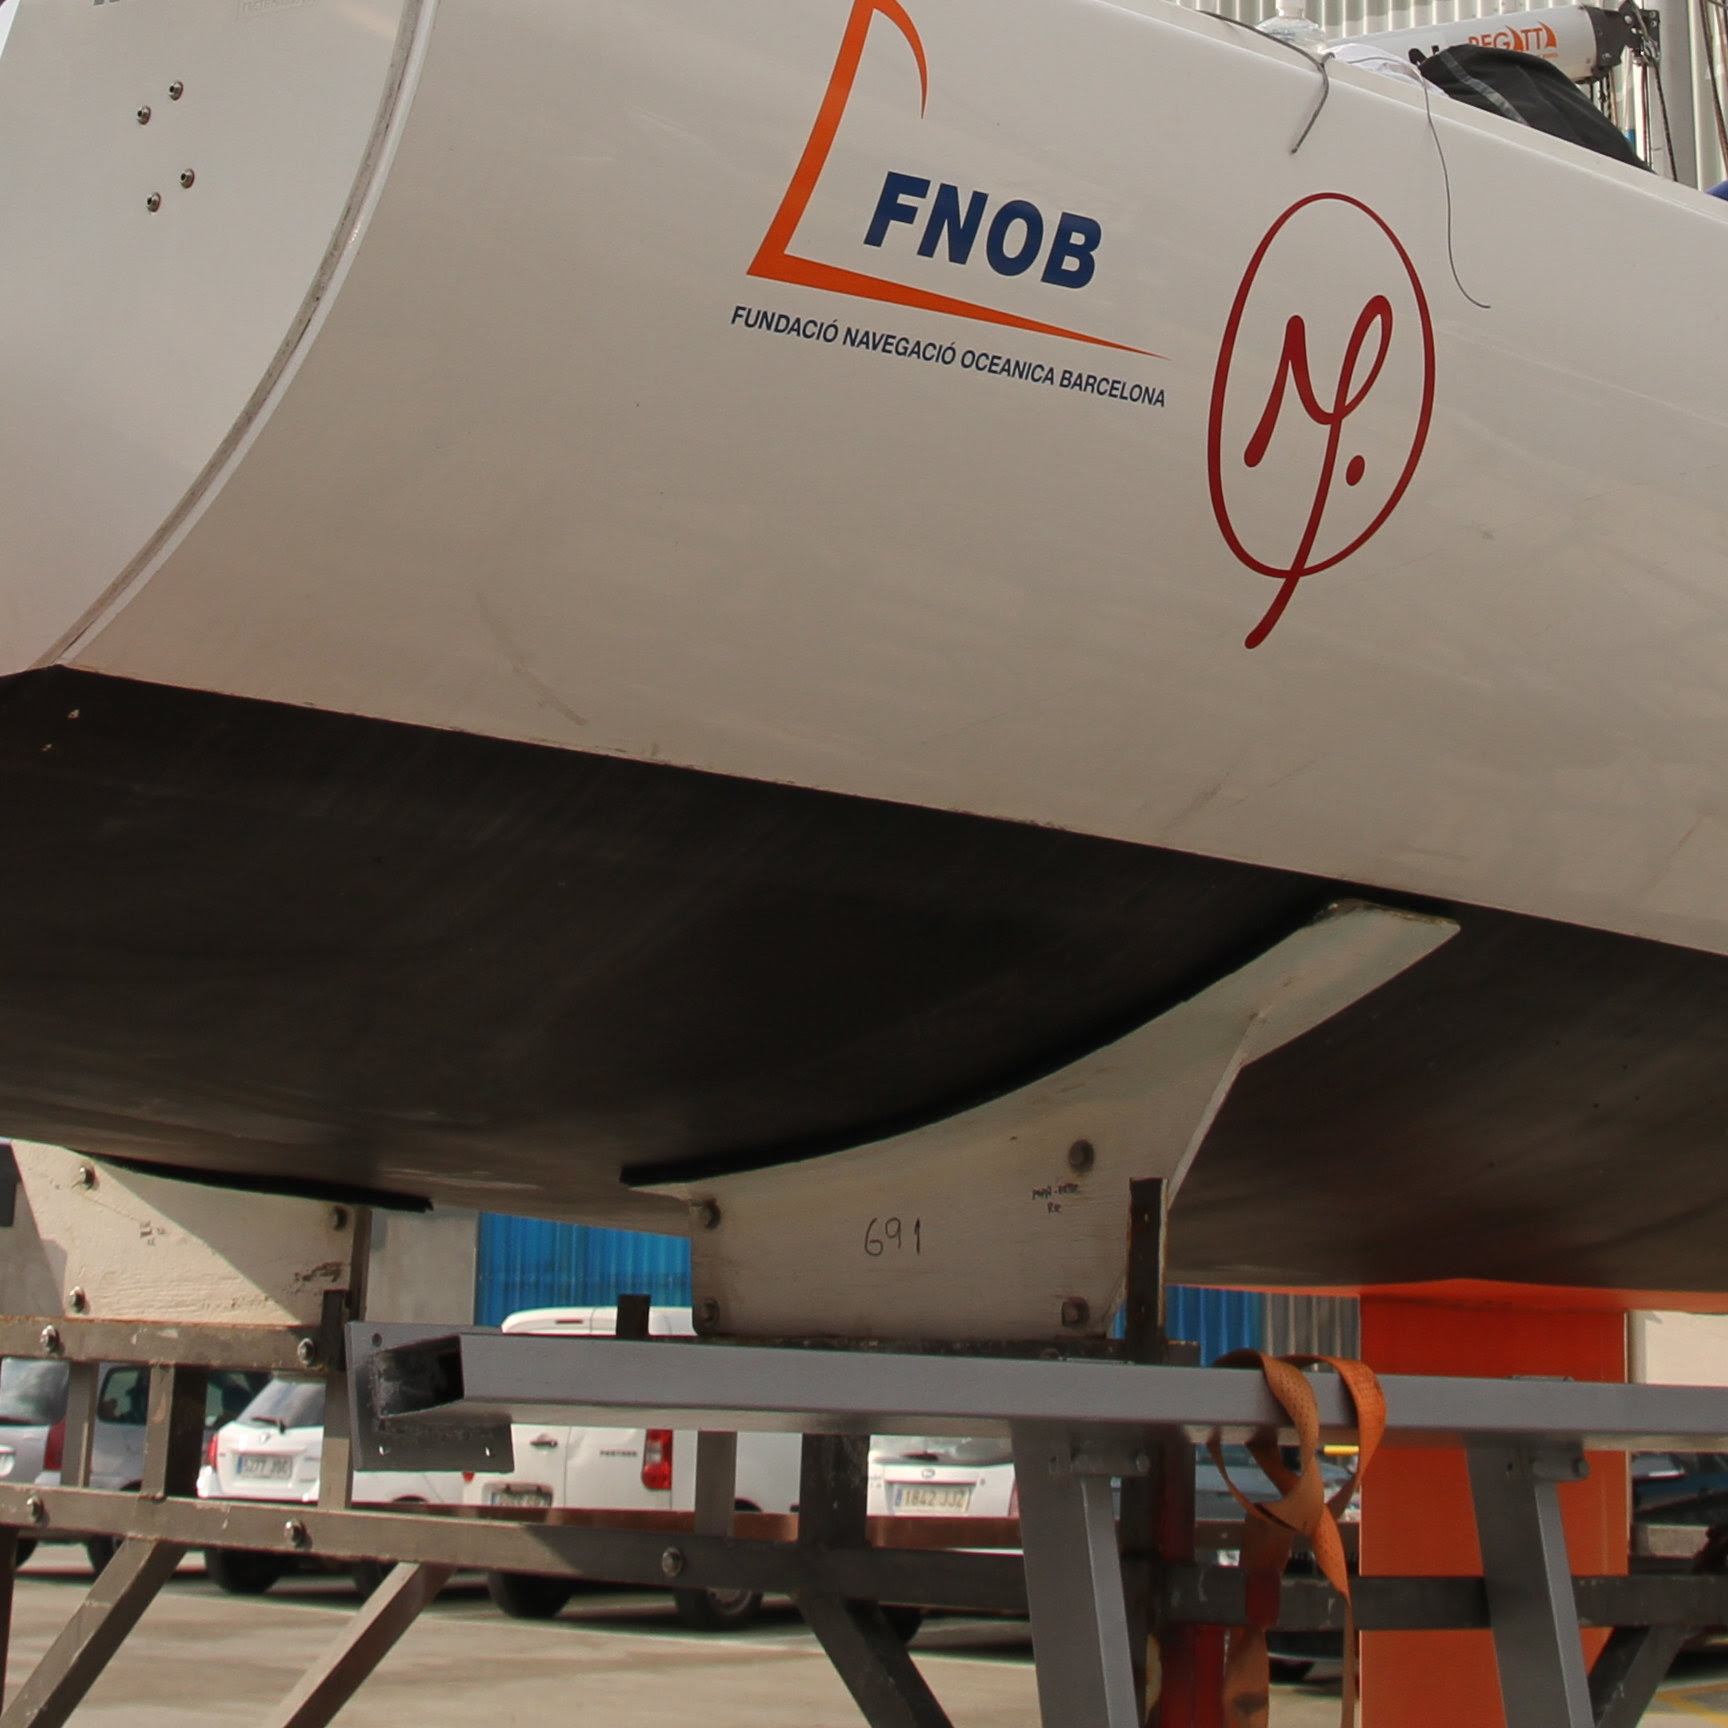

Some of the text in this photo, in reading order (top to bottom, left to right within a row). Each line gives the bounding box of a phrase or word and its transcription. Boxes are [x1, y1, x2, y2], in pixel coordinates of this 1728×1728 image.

[863, 171, 1102, 289] FNOB
[731, 305, 1167, 408] FUNDACIÓ NAVEGACIÓ OCEANICA BARCELONA
[864, 1217, 922, 1256] 691
